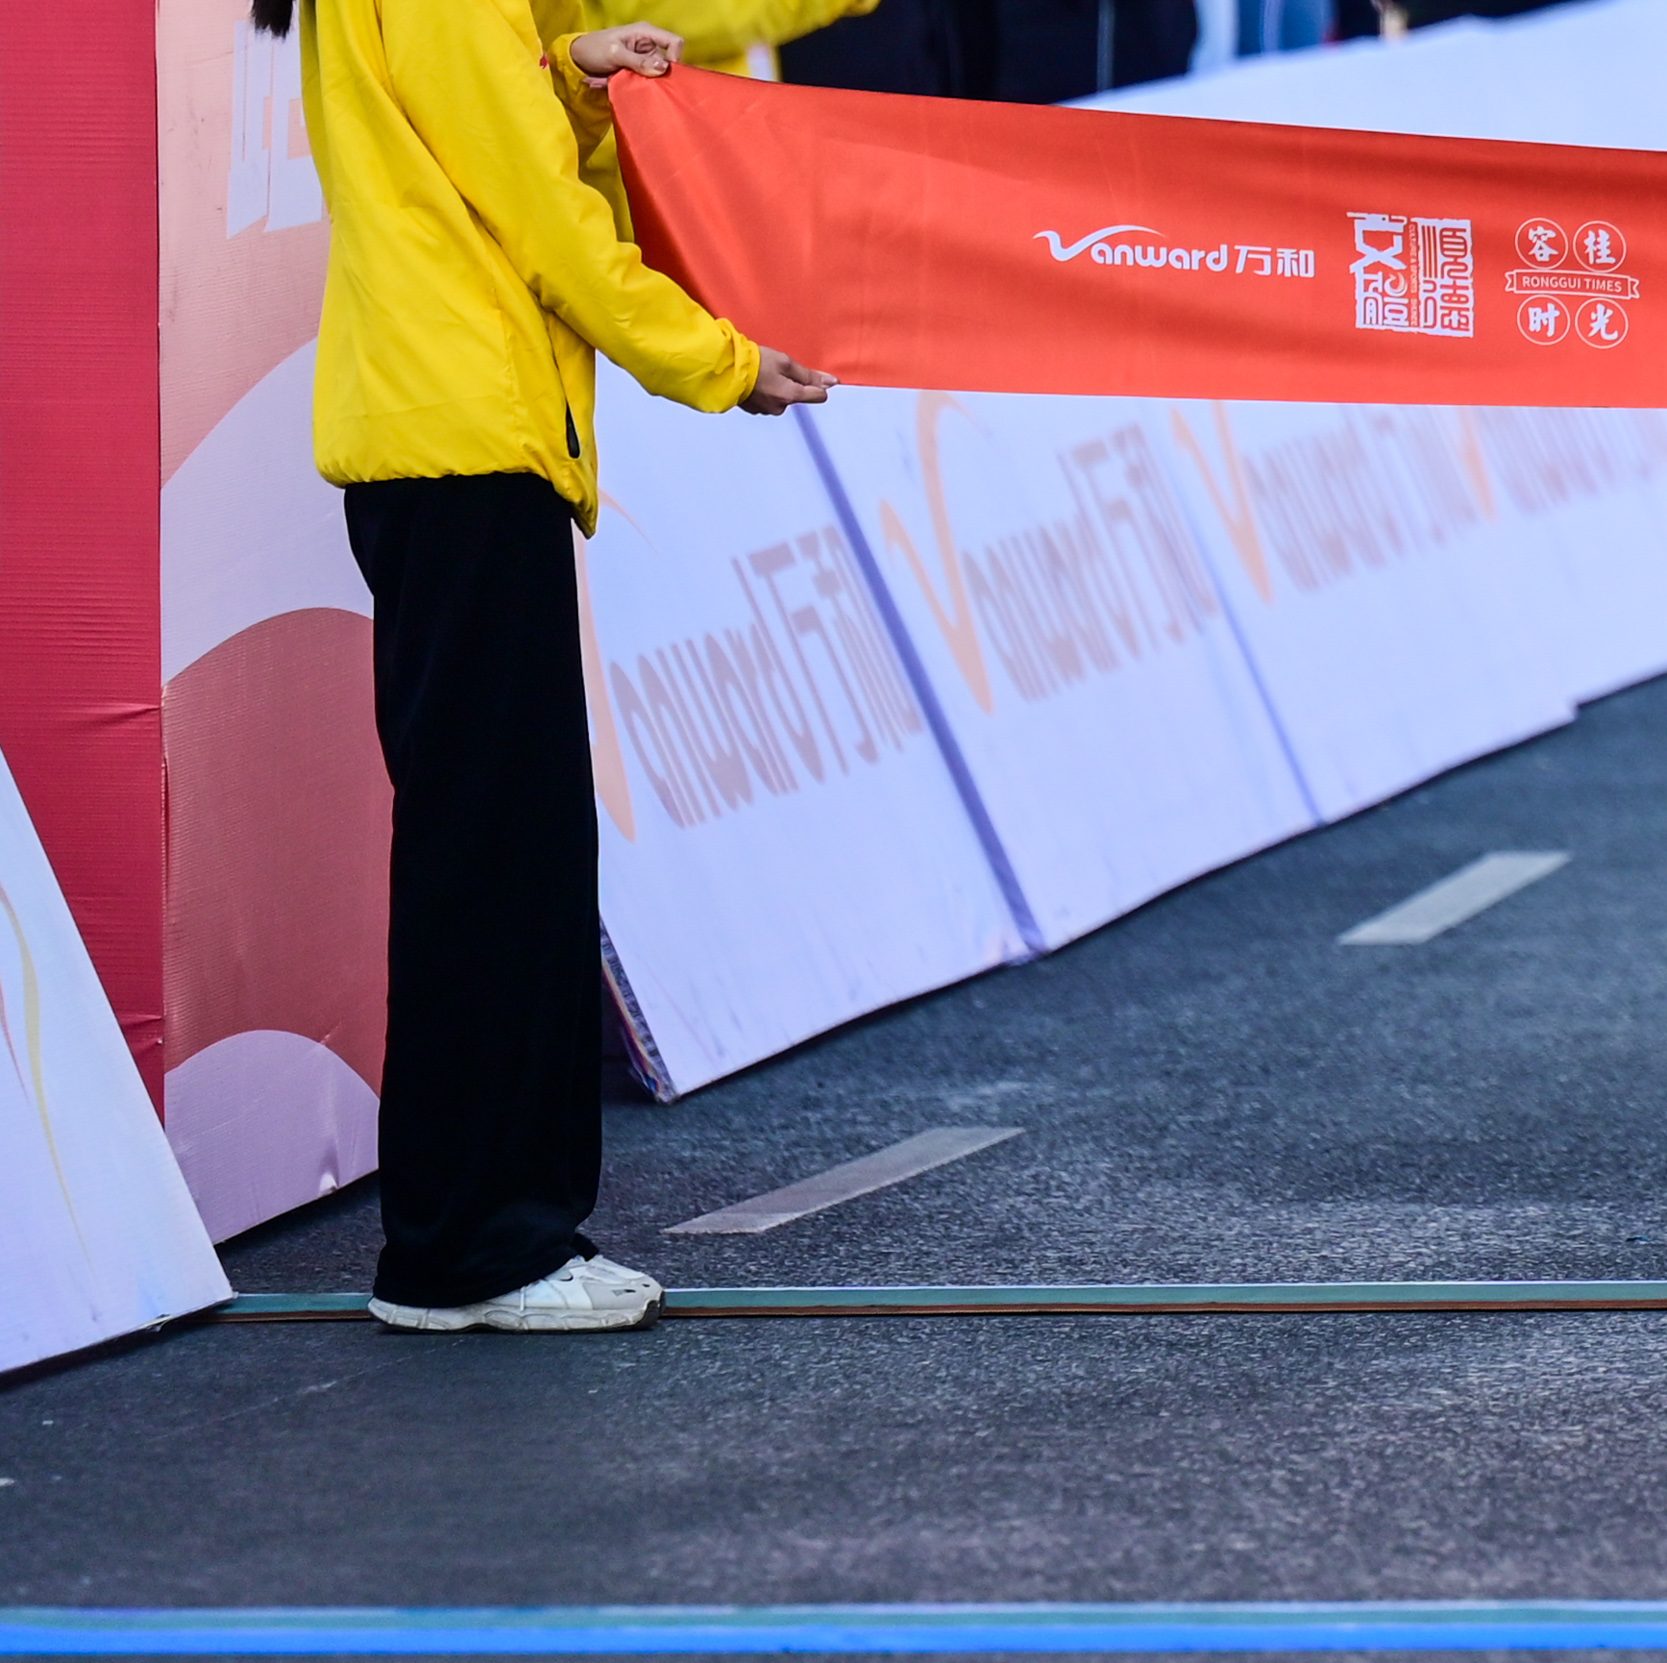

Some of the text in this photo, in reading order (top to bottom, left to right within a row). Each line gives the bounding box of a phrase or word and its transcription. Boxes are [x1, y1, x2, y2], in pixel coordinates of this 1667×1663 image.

[1032, 224, 1315, 278] Vanward 万和
[1528, 225, 1617, 265] 容桂
[1522, 275, 1623, 293] RONGGUI TIMES
[1528, 302, 1619, 341] 时光
